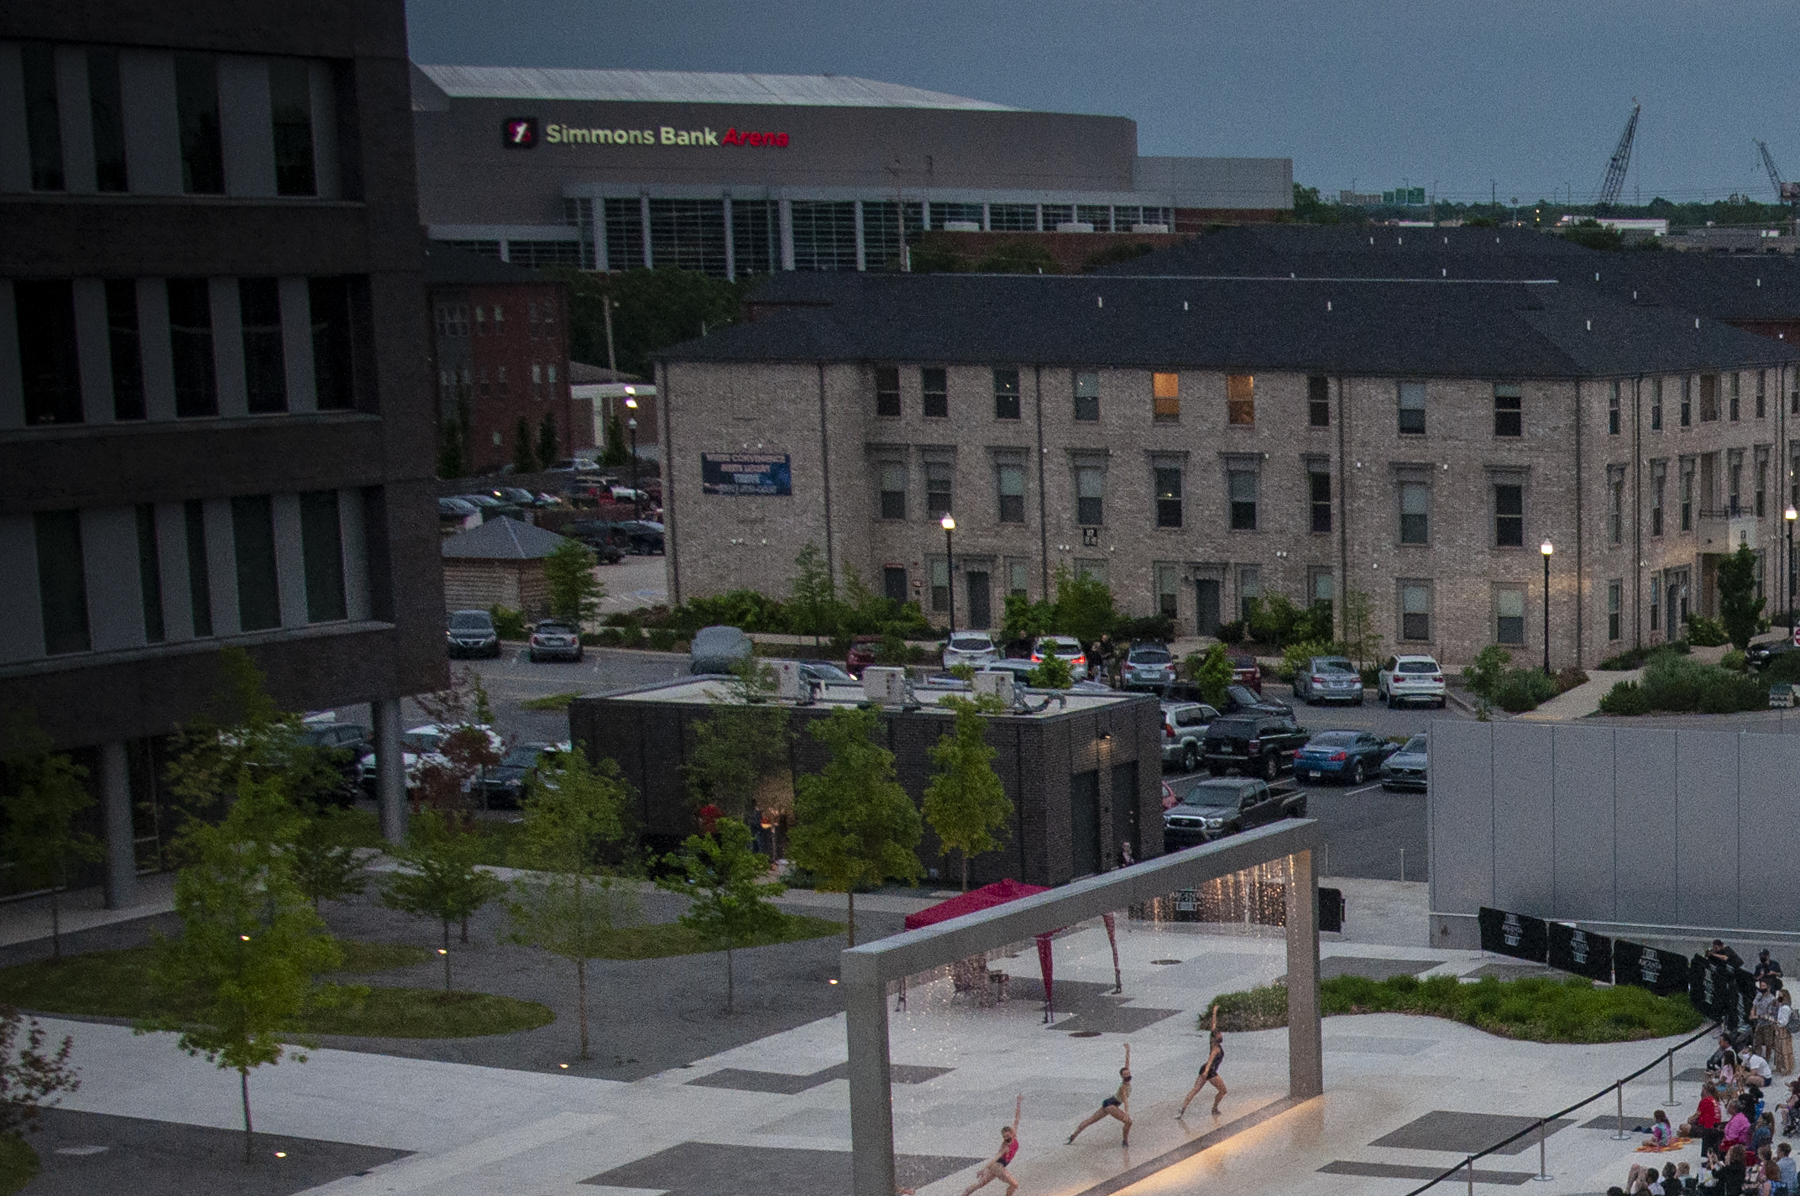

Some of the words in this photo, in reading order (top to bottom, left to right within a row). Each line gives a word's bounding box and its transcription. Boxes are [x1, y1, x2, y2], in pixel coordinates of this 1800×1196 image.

[546, 124, 655, 146] Simmons
[660, 125, 719, 147] Bank
[721, 126, 789, 147] Arena
